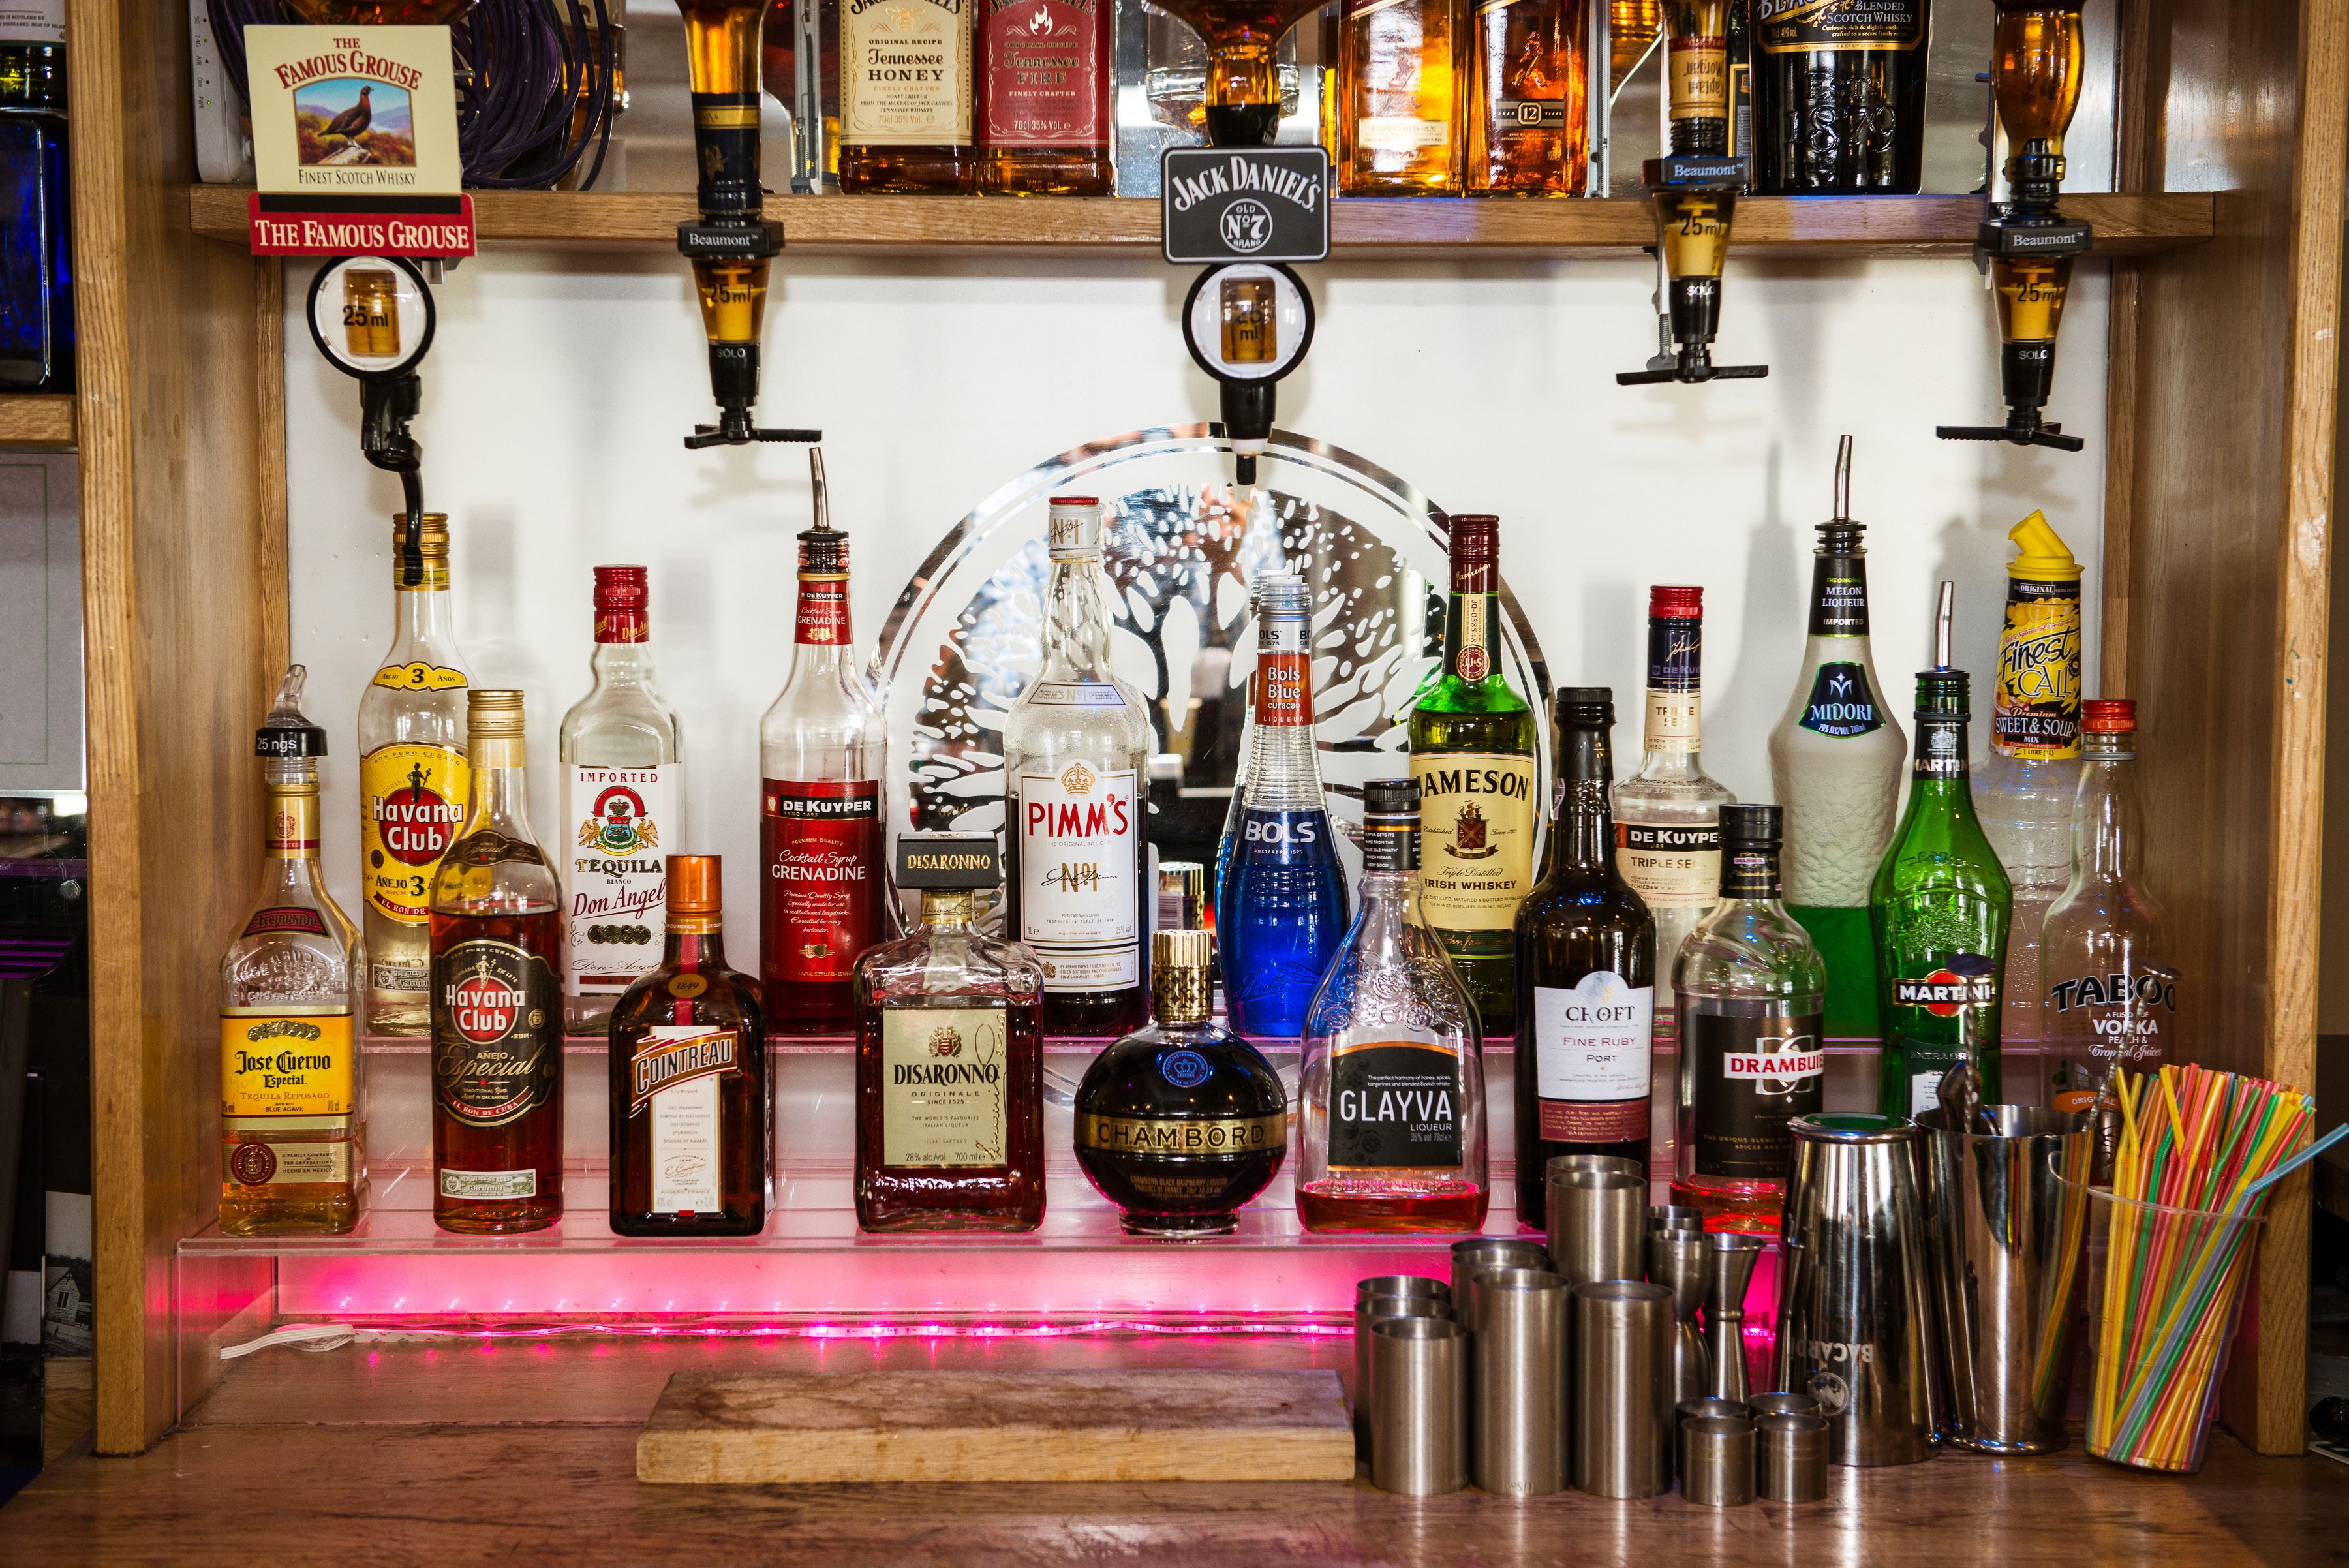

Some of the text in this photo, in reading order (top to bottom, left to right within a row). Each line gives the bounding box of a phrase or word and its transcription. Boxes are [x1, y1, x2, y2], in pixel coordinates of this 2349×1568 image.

[1855, 1, 1904, 11] BLENDED
[1827, 12, 1912, 23] SCOTCH WHISKY
[333, 38, 360, 48] THE
[868, 48, 943, 64] Tennessee
[1004, 51, 1079, 69] Tennessee
[274, 50, 423, 90] FAMOUS GROUSE
[868, 70, 944, 81] HONEY
[1017, 71, 1066, 84] FIRE
[1523, 106, 1536, 120] 12
[1032, 121, 1047, 130] 35%
[1786, 106, 1896, 153] 1879
[299, 169, 416, 185] FINEST SCOTCH WHISKY
[1172, 156, 1321, 211] JACK DANIEL'S
[1236, 206, 1255, 214] OLD
[255, 219, 470, 249] THE FAMOUS GROUSE
[1233, 239, 1261, 248] BRAND
[710, 284, 729, 303] 25
[2017, 283, 2040, 302] 25
[343, 305, 388, 327] 25 ml
[717, 348, 746, 358] SOLO
[2019, 351, 2048, 360] SOLO
[1456, 563, 1491, 587] Jameson
[2020, 584, 2054, 593] ORIGINAL
[1822, 598, 1865, 607] LIQUEUR
[798, 616, 845, 624] GRENADINE
[1999, 626, 2079, 682] Finest
[1463, 658, 1482, 668] JJ&S
[412, 669, 424, 683] 3
[1268, 666, 1300, 681] Bols
[2017, 666, 2077, 699] CALL
[1268, 684, 1300, 698] Blue
[1810, 703, 1873, 721] MIDORI
[2011, 706, 2057, 718] Premium
[1995, 717, 2074, 737] SWEET & SOUR
[258, 738, 297, 752] 25 ngs
[375, 754, 388, 763] RON
[423, 752, 460, 765] CUBANO
[581, 773, 658, 782] IMPORTED
[372, 796, 463, 822] Havana
[807, 801, 871, 813] KUYPER
[1028, 793, 1128, 837] PIMM'S
[1244, 820, 1315, 843] BOLS
[1424, 825, 1454, 835] Established
[1657, 831, 1718, 844] KUYPE
[388, 826, 442, 850] Club
[779, 850, 857, 867] Cocktail Syrup
[907, 854, 990, 870] DISARONNO
[1631, 857, 1700, 869] TRIPLE SEC
[575, 859, 663, 878] TEQUILA
[772, 864, 865, 881] GRENADINE
[1437, 866, 1503, 879] Triple Distilled
[376, 874, 425, 896] AÑEJO 3
[1425, 878, 1516, 890] IRISH WHISKEY
[382, 899, 391, 909] EL
[393, 904, 409, 914] RON
[572, 878, 666, 920] Don Angel
[788, 900, 811, 908] Specially
[256, 914, 316, 928] Reposado
[445, 985, 525, 1007] Havana
[1899, 985, 1991, 1001] MARTINI
[459, 1009, 507, 1032] Club
[1563, 1037, 1636, 1047] FINE RUBY
[235, 1051, 331, 1075] Jose Cuervo
[476, 1051, 508, 1061] AÑEJO
[1730, 1054, 1824, 1072] DRAMBUIE
[437, 1043, 546, 1088] Especial
[636, 1038, 732, 1094] COINTREAU
[894, 1064, 998, 1086] DISARONNO
[496, 1101, 518, 1114] CUBA
[1340, 1090, 1452, 1122] GLAYVA
[1411, 1123, 1452, 1131] LIQUEUR
[1098, 1122, 1265, 1149] CHAMBORD
[906, 1153, 921, 1161] 28%
